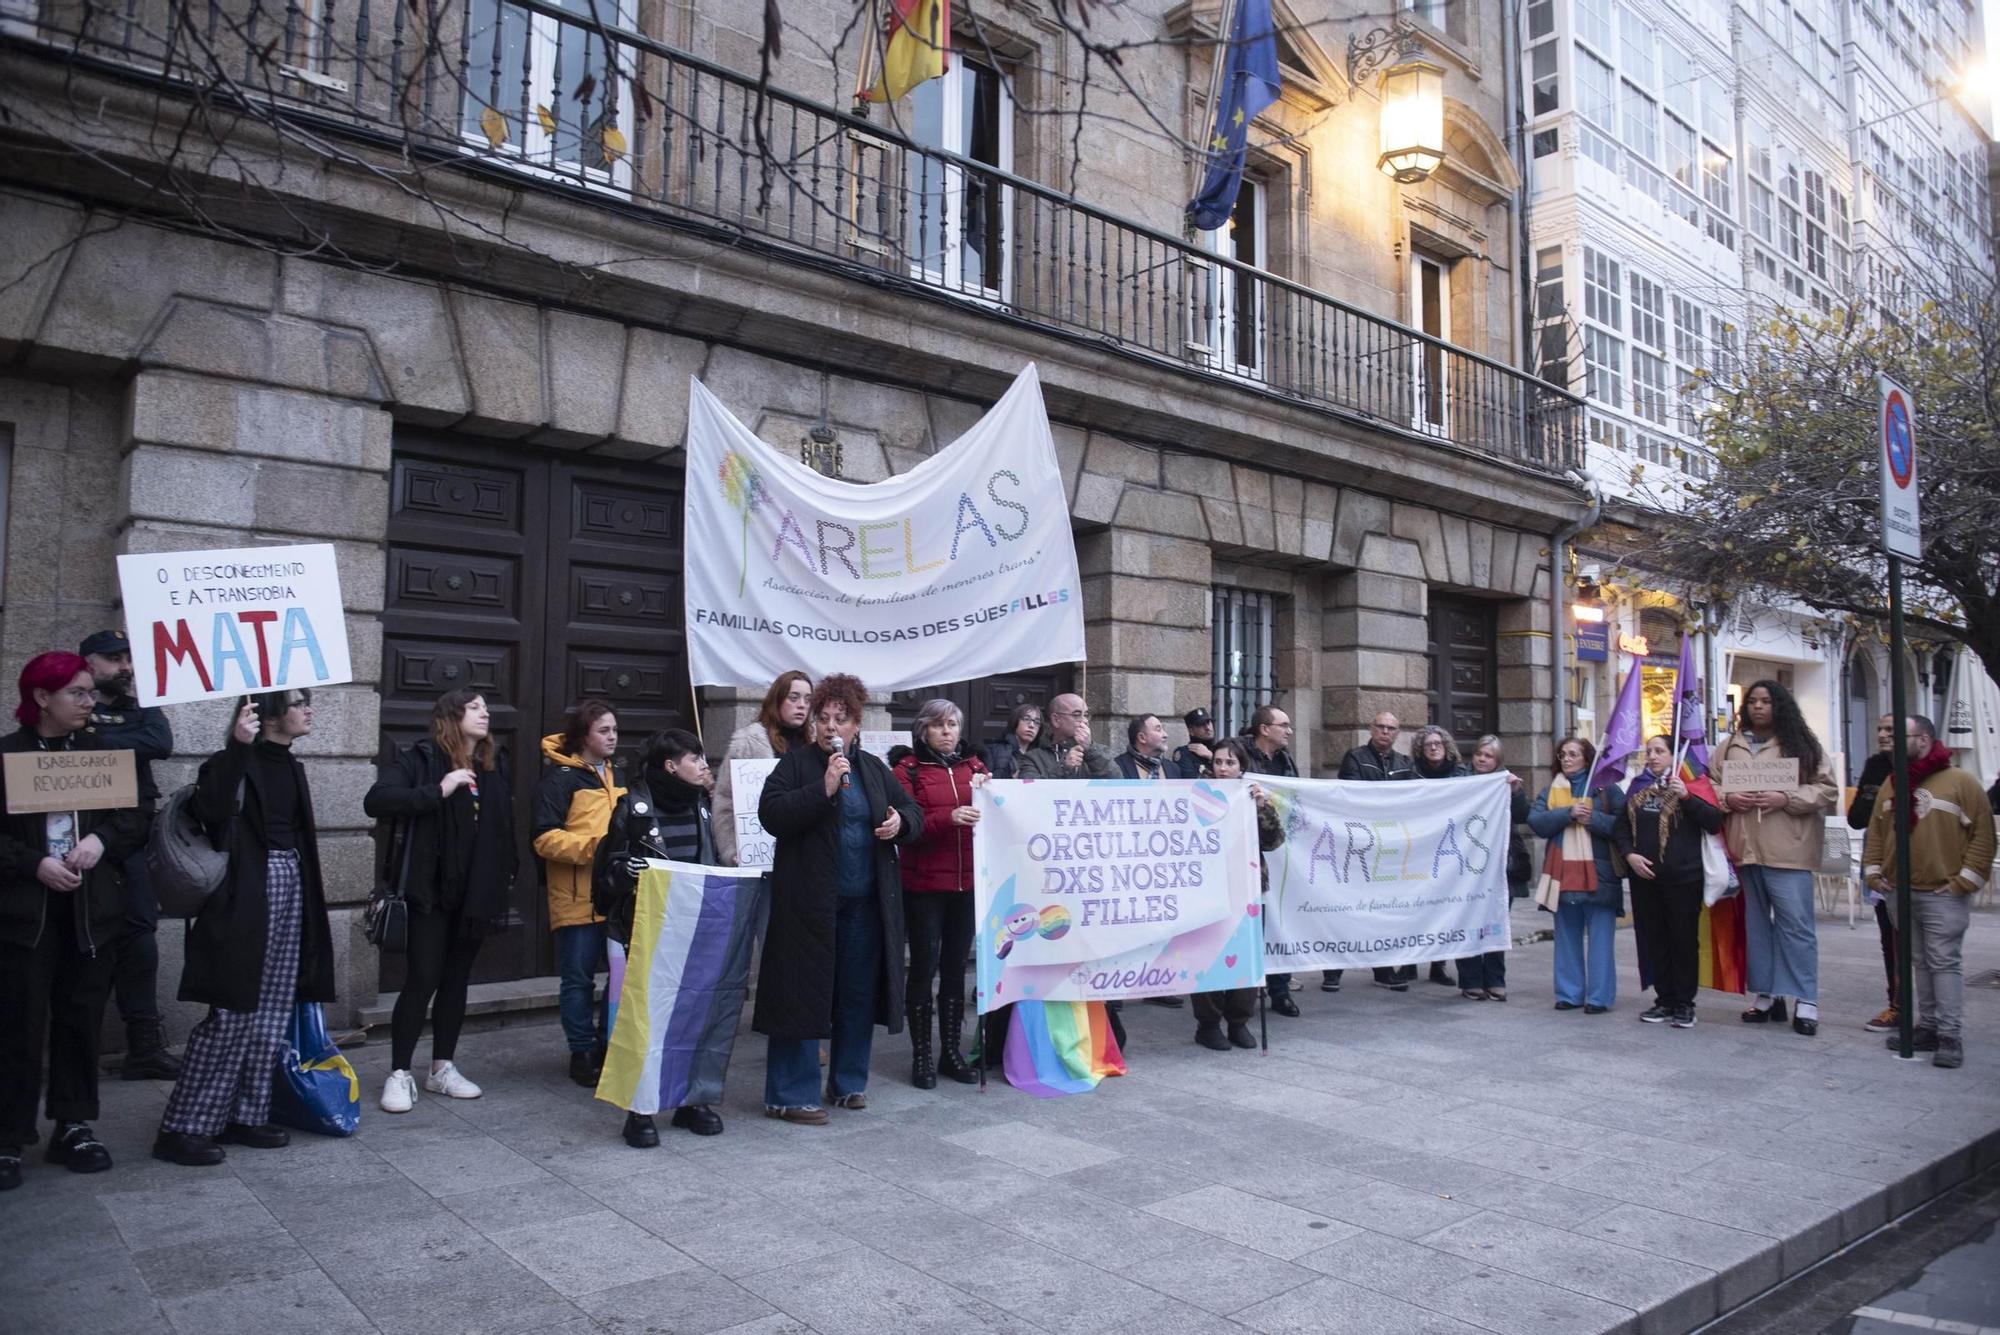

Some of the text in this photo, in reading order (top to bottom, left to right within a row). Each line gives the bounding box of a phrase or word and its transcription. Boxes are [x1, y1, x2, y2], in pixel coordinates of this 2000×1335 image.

[771, 468, 1030, 580] ARELAS
[157, 568, 169, 584] O
[170, 585, 297, 606] E A TRANSFOBIA
[696, 587, 1070, 644] FAMILIAS ORGULLOSAS DES SÚES FILLES
[152, 607, 330, 697] MATA
[37, 755, 79, 770] ISABEL
[1054, 798, 1190, 826] FAMILIAS
[1027, 829, 1222, 862] ORGULLOSAS
[1308, 814, 1491, 885] ARELAS
[1040, 861, 1204, 894] DXS NOSXS
[1081, 895, 1179, 926] FILLES
[1263, 941, 1311, 956] MILIAS
[1313, 937, 1406, 953] ORGULLOSAS
[1407, 933, 1436, 948] DES
[1090, 962, 1176, 990] arelas
